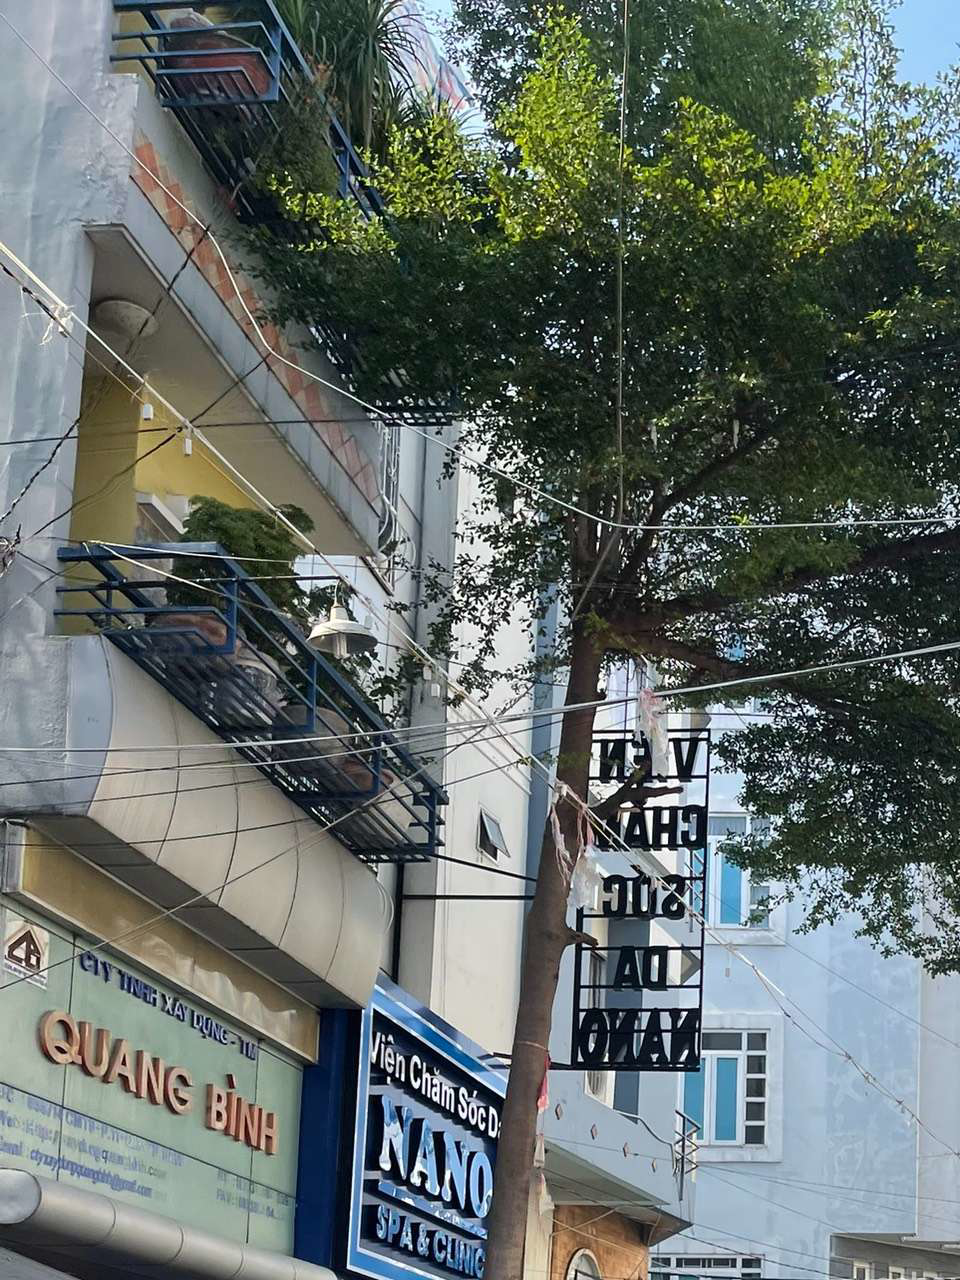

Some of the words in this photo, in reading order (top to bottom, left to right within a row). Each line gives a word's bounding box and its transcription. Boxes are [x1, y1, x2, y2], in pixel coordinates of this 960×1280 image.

[39, 1009, 194, 1116] QUANG
[206, 1074, 280, 1156] BÌNH
[370, 1032, 405, 1084] Viện
[410, 1055, 455, 1113] Chăm
[458, 1087, 487, 1131] Sóc
[488, 1108, 502, 1139] D
[379, 1094, 494, 1219] NANO
[376, 1204, 414, 1252] SPA
[417, 1223, 430, 1257] &
